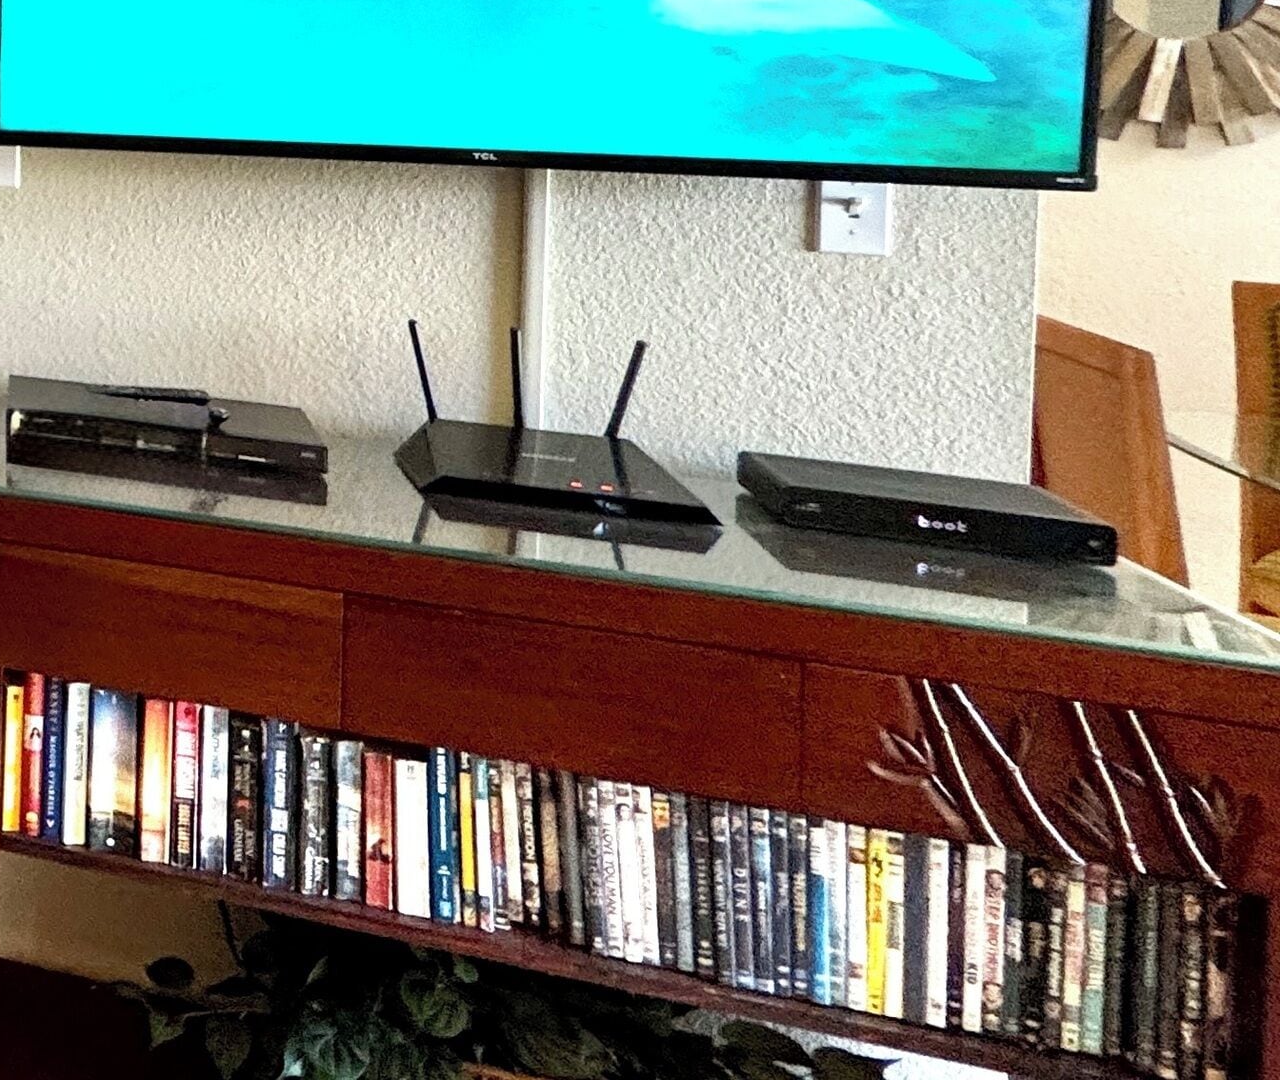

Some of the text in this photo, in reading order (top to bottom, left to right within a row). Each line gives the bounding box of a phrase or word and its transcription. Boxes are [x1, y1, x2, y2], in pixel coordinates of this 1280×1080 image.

[471, 152, 498, 161] TCL
[916, 514, 969, 534] boot
[604, 860, 616, 884] YOU
[606, 887, 618, 916] MAN
[733, 867, 750, 924] DUNE
[967, 961, 978, 985] KID
